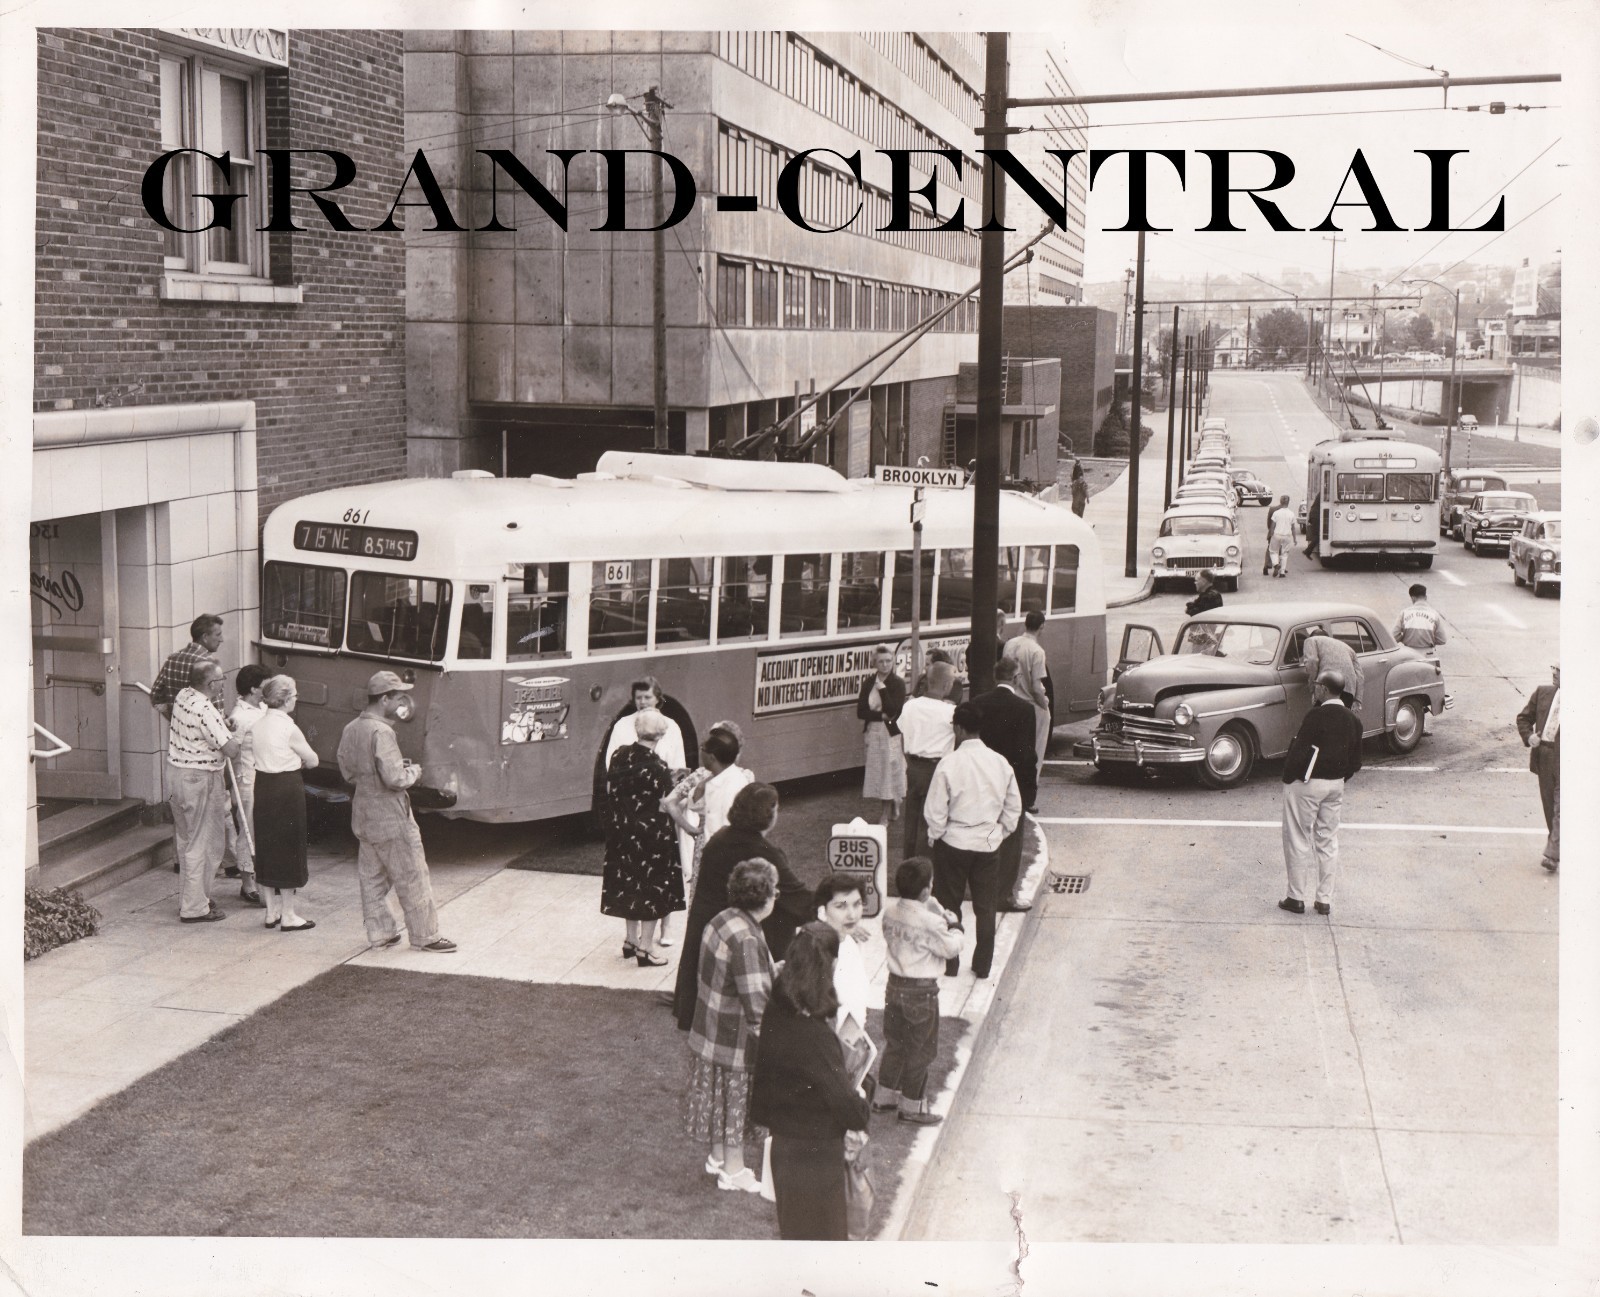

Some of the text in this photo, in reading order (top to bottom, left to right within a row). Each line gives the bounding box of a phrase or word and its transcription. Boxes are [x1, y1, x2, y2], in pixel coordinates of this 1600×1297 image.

[882, 469, 957, 486] BROOKLYN
[343, 508, 370, 524] 861
[302, 527, 311, 548] 7
[332, 528, 352, 550] NE
[364, 537, 396, 557] 85TH
[397, 541, 414, 558] ST
[608, 565, 629, 580] 861
[761, 658, 799, 682] ACCOUNT
[800, 654, 835, 678] OPENED
[836, 653, 845, 673] IN
[845, 651, 853, 673] 5
[514, 686, 563, 704] FAIR
[757, 687, 770, 707] NO
[822, 675, 860, 698] CARRYING
[526, 702, 561, 711] PUYALLUP
[840, 840, 868, 853] BUS
[834, 854, 874, 868] ZONE
